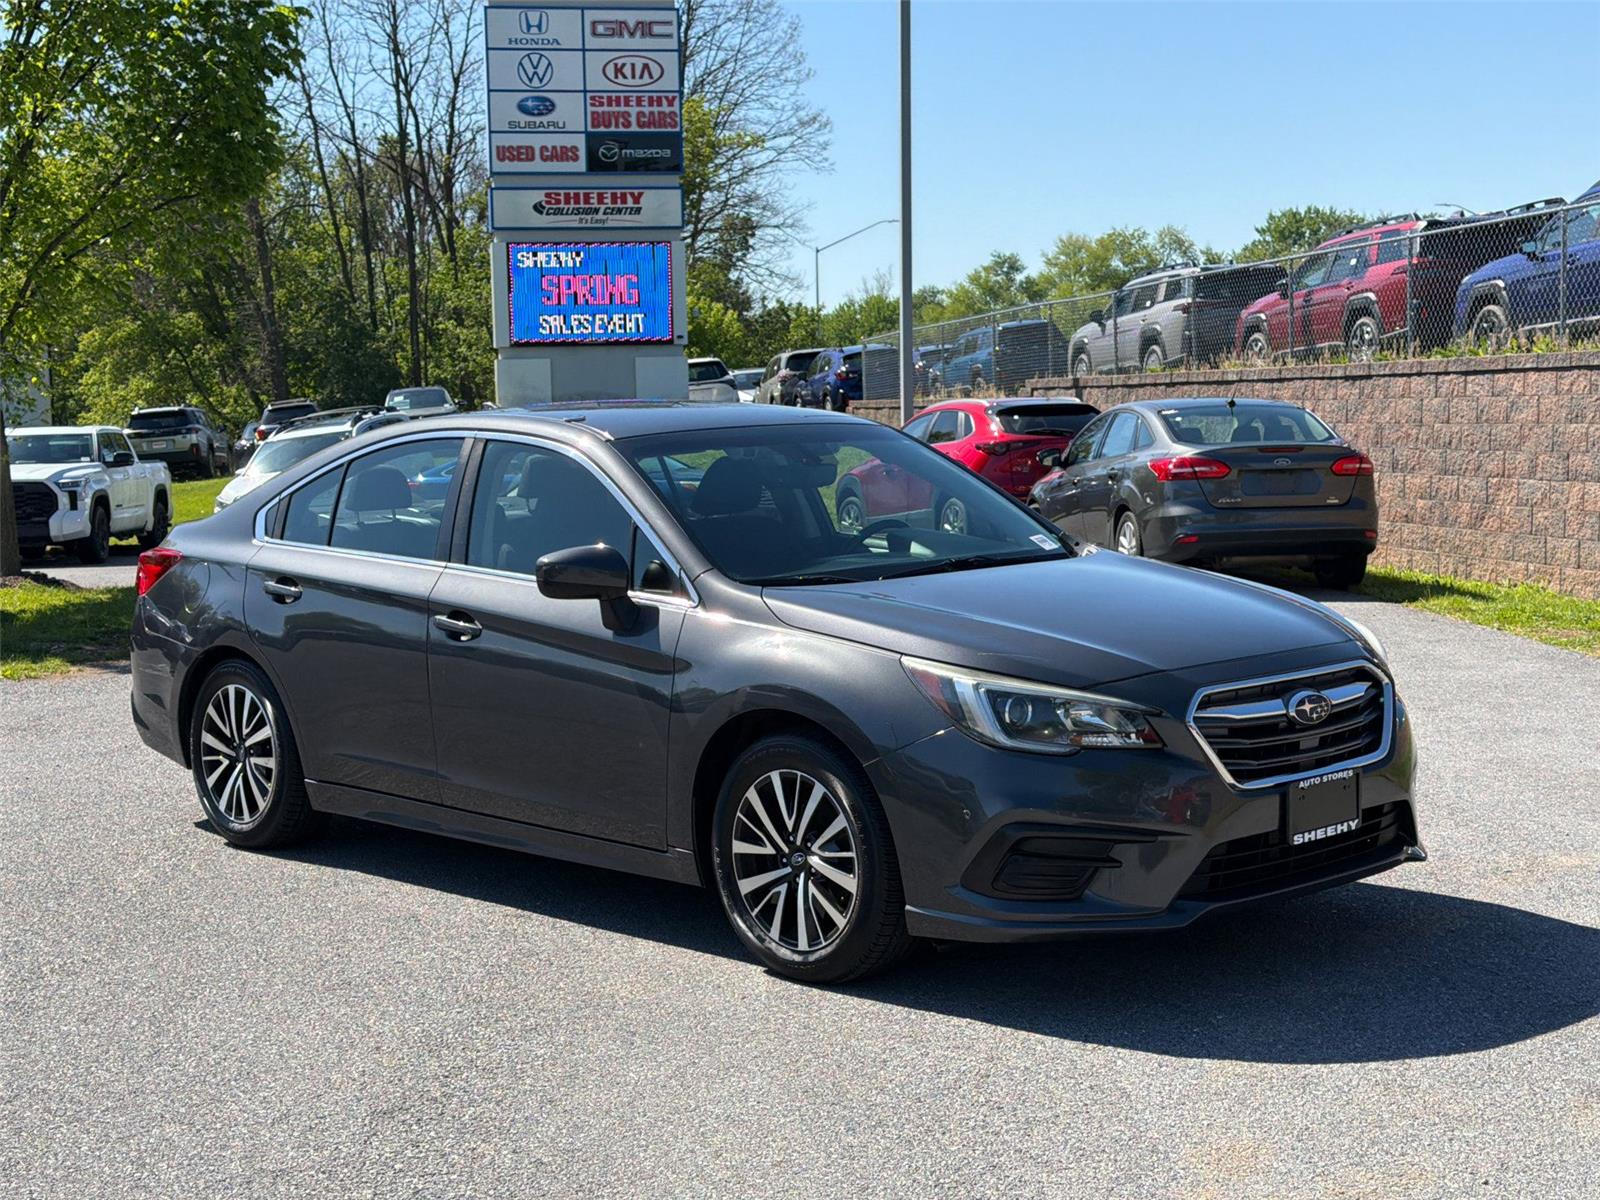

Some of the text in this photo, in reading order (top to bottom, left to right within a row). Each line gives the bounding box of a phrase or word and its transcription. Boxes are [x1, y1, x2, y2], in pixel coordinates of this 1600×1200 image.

[590, 20, 674, 39] GMC
[508, 37, 562, 46] HONDA
[613, 62, 655, 80] KIA
[589, 95, 678, 108] SHEEHY
[508, 120, 566, 130] SUBARU
[590, 111, 678, 129] BUYS CARS
[496, 145, 580, 163] USED CARS
[544, 191, 645, 206] SHEEHY
[545, 206, 643, 216] COLLISION CENTER
[577, 217, 609, 226] It's Easy!
[517, 251, 584, 269] SHEEHY
[541, 274, 640, 306] SPRING
[539, 313, 646, 335] SALES EVENT
[1298, 769, 1354, 789] AUTO STORES
[1292, 818, 1360, 845] SHEEHY
